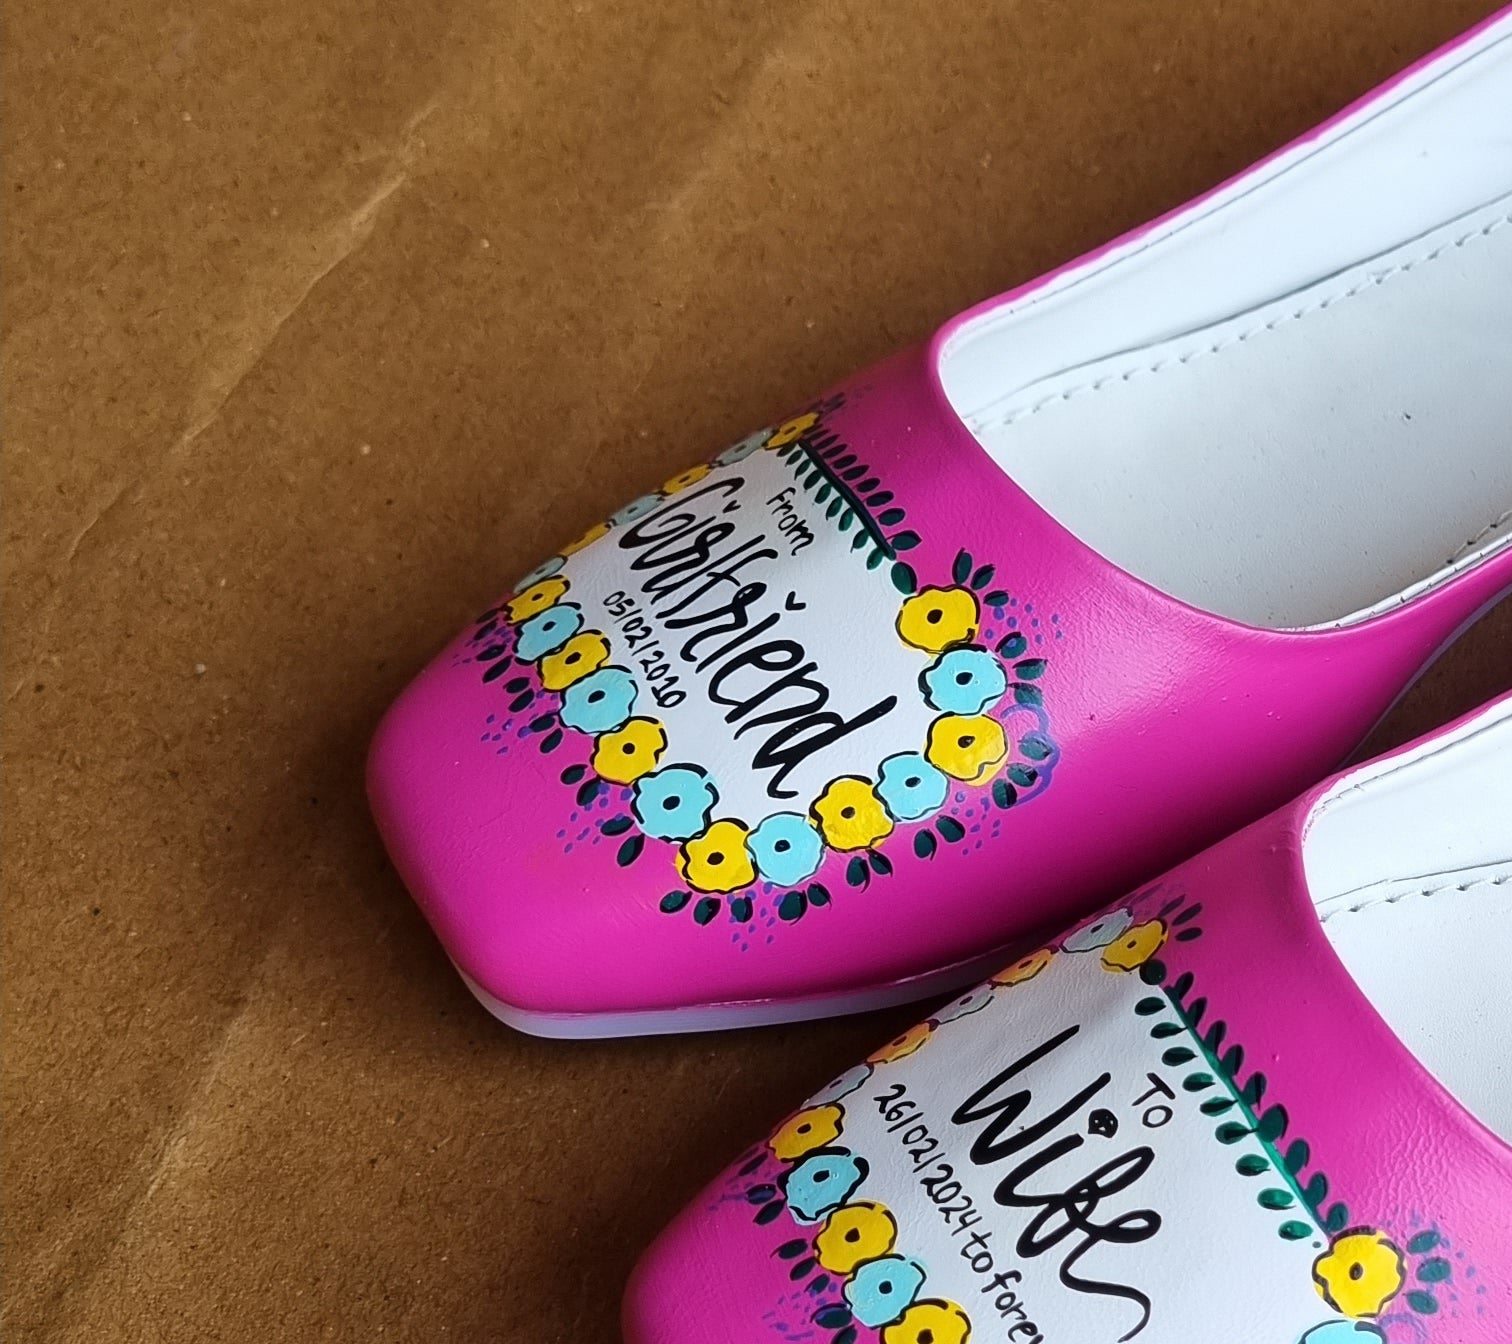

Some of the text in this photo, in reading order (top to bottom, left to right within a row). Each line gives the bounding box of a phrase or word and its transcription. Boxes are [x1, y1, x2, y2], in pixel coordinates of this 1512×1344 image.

[602, 589, 687, 709] 05/02/2010
[618, 476, 898, 800] Girlfriend
[872, 1083, 984, 1237] 26/02/2024
[959, 1231, 995, 1274] to
[951, 1023, 1163, 1344] Wife
